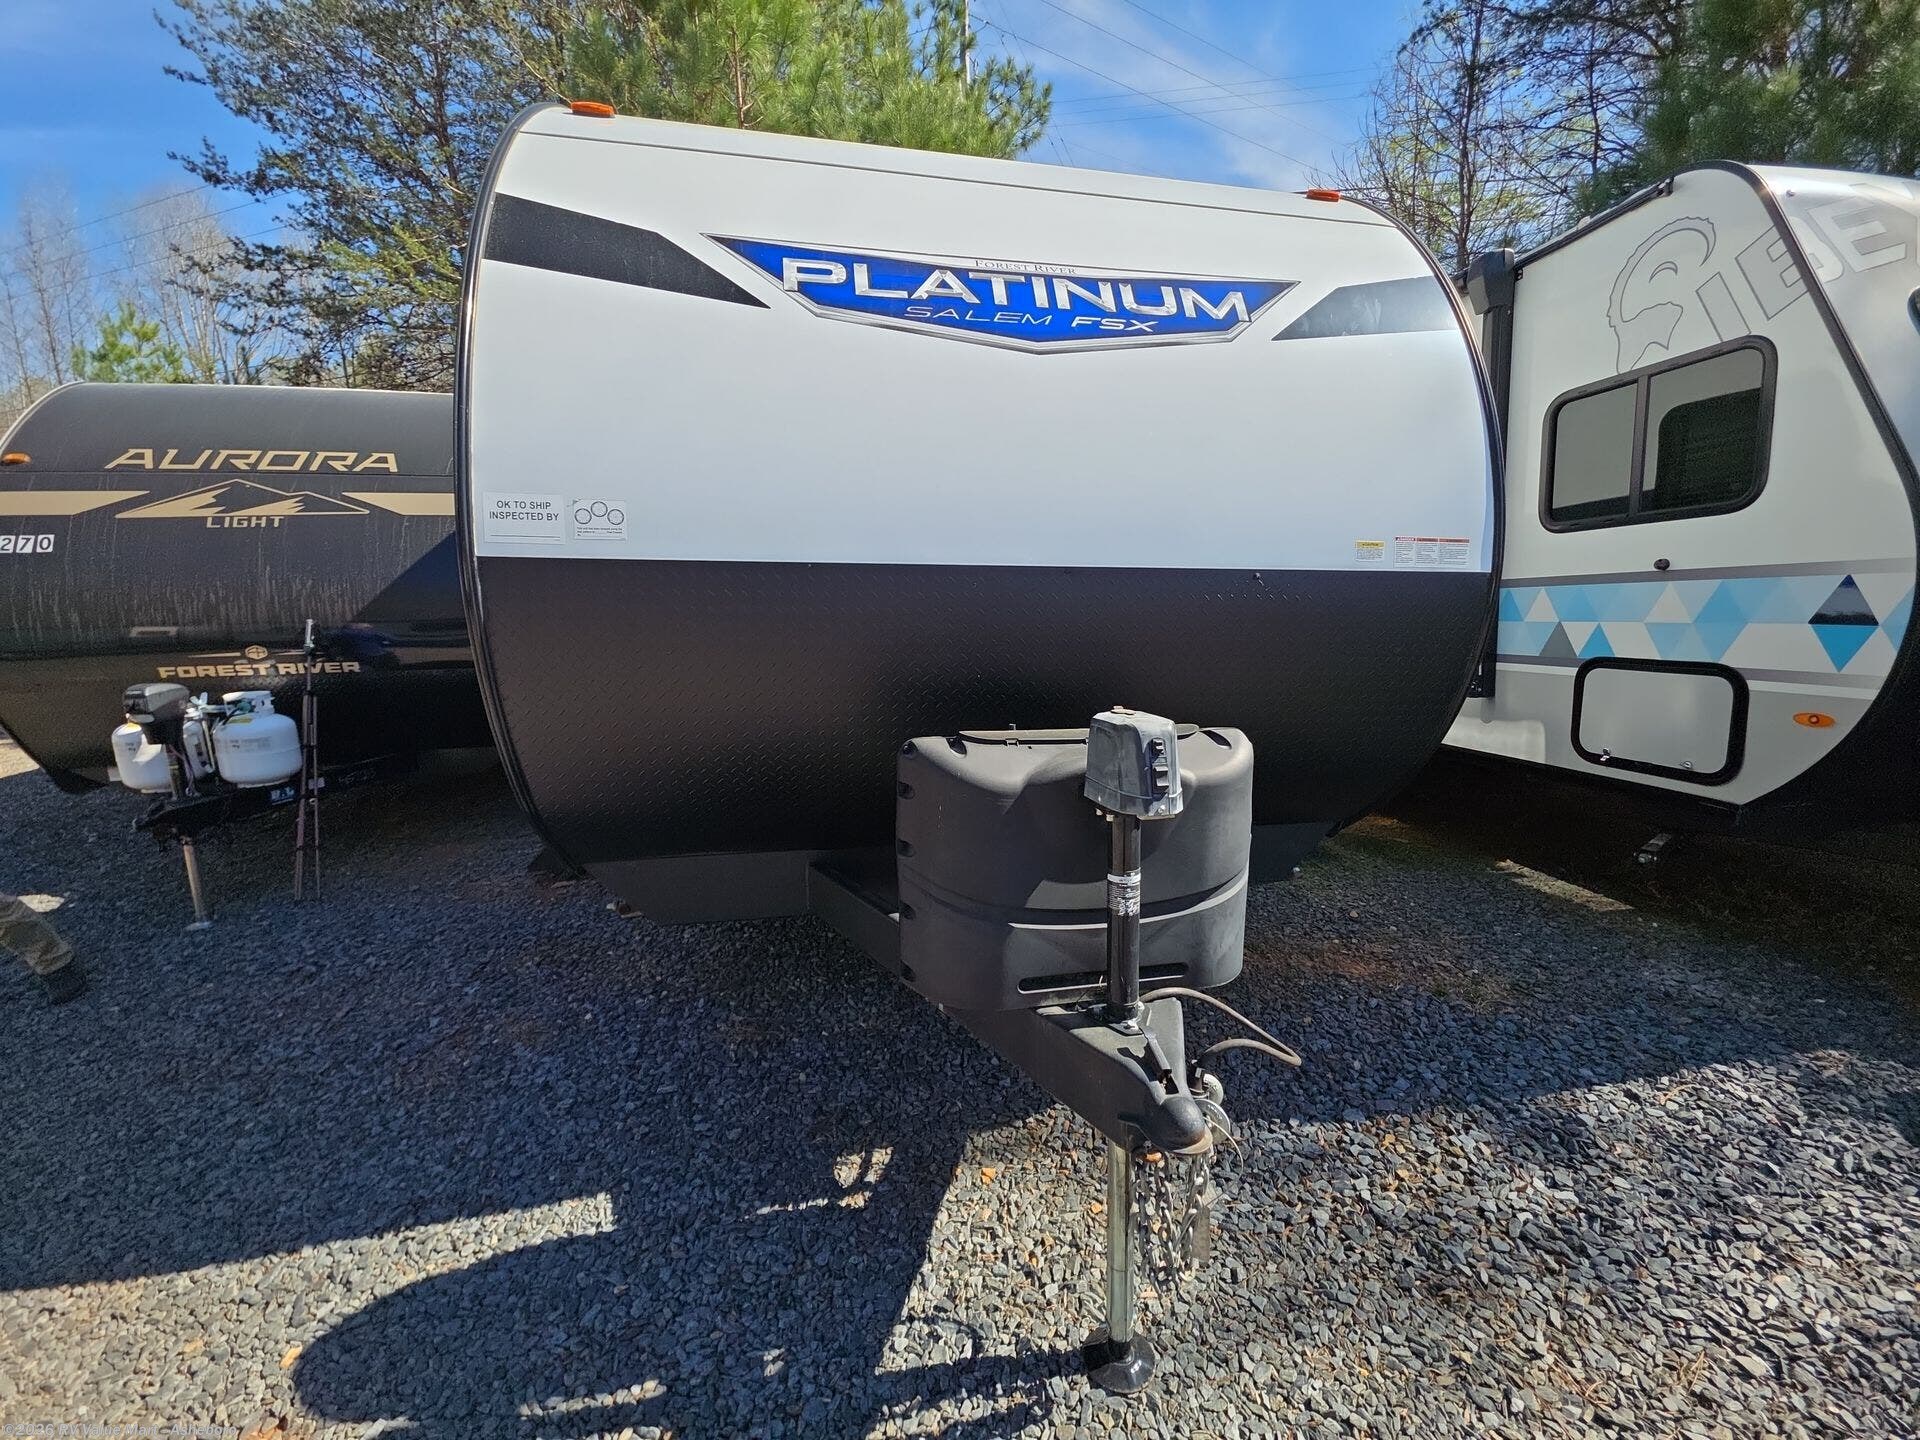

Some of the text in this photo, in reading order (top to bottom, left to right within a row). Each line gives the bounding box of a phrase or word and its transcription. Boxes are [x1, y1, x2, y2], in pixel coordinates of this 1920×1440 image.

[975, 260, 1077, 274] FOREST RIVER
[783, 257, 1253, 323] PLATINUM
[905, 305, 1159, 333] SALEM FSX
[105, 448, 398, 473] AURORA
[496, 500, 551, 510] OK TO SHIP
[206, 515, 285, 529] LIGHT
[489, 511, 559, 521] INSPECTED BY
[0, 536, 52, 552] 270
[157, 661, 361, 679] FOREST RIVER
